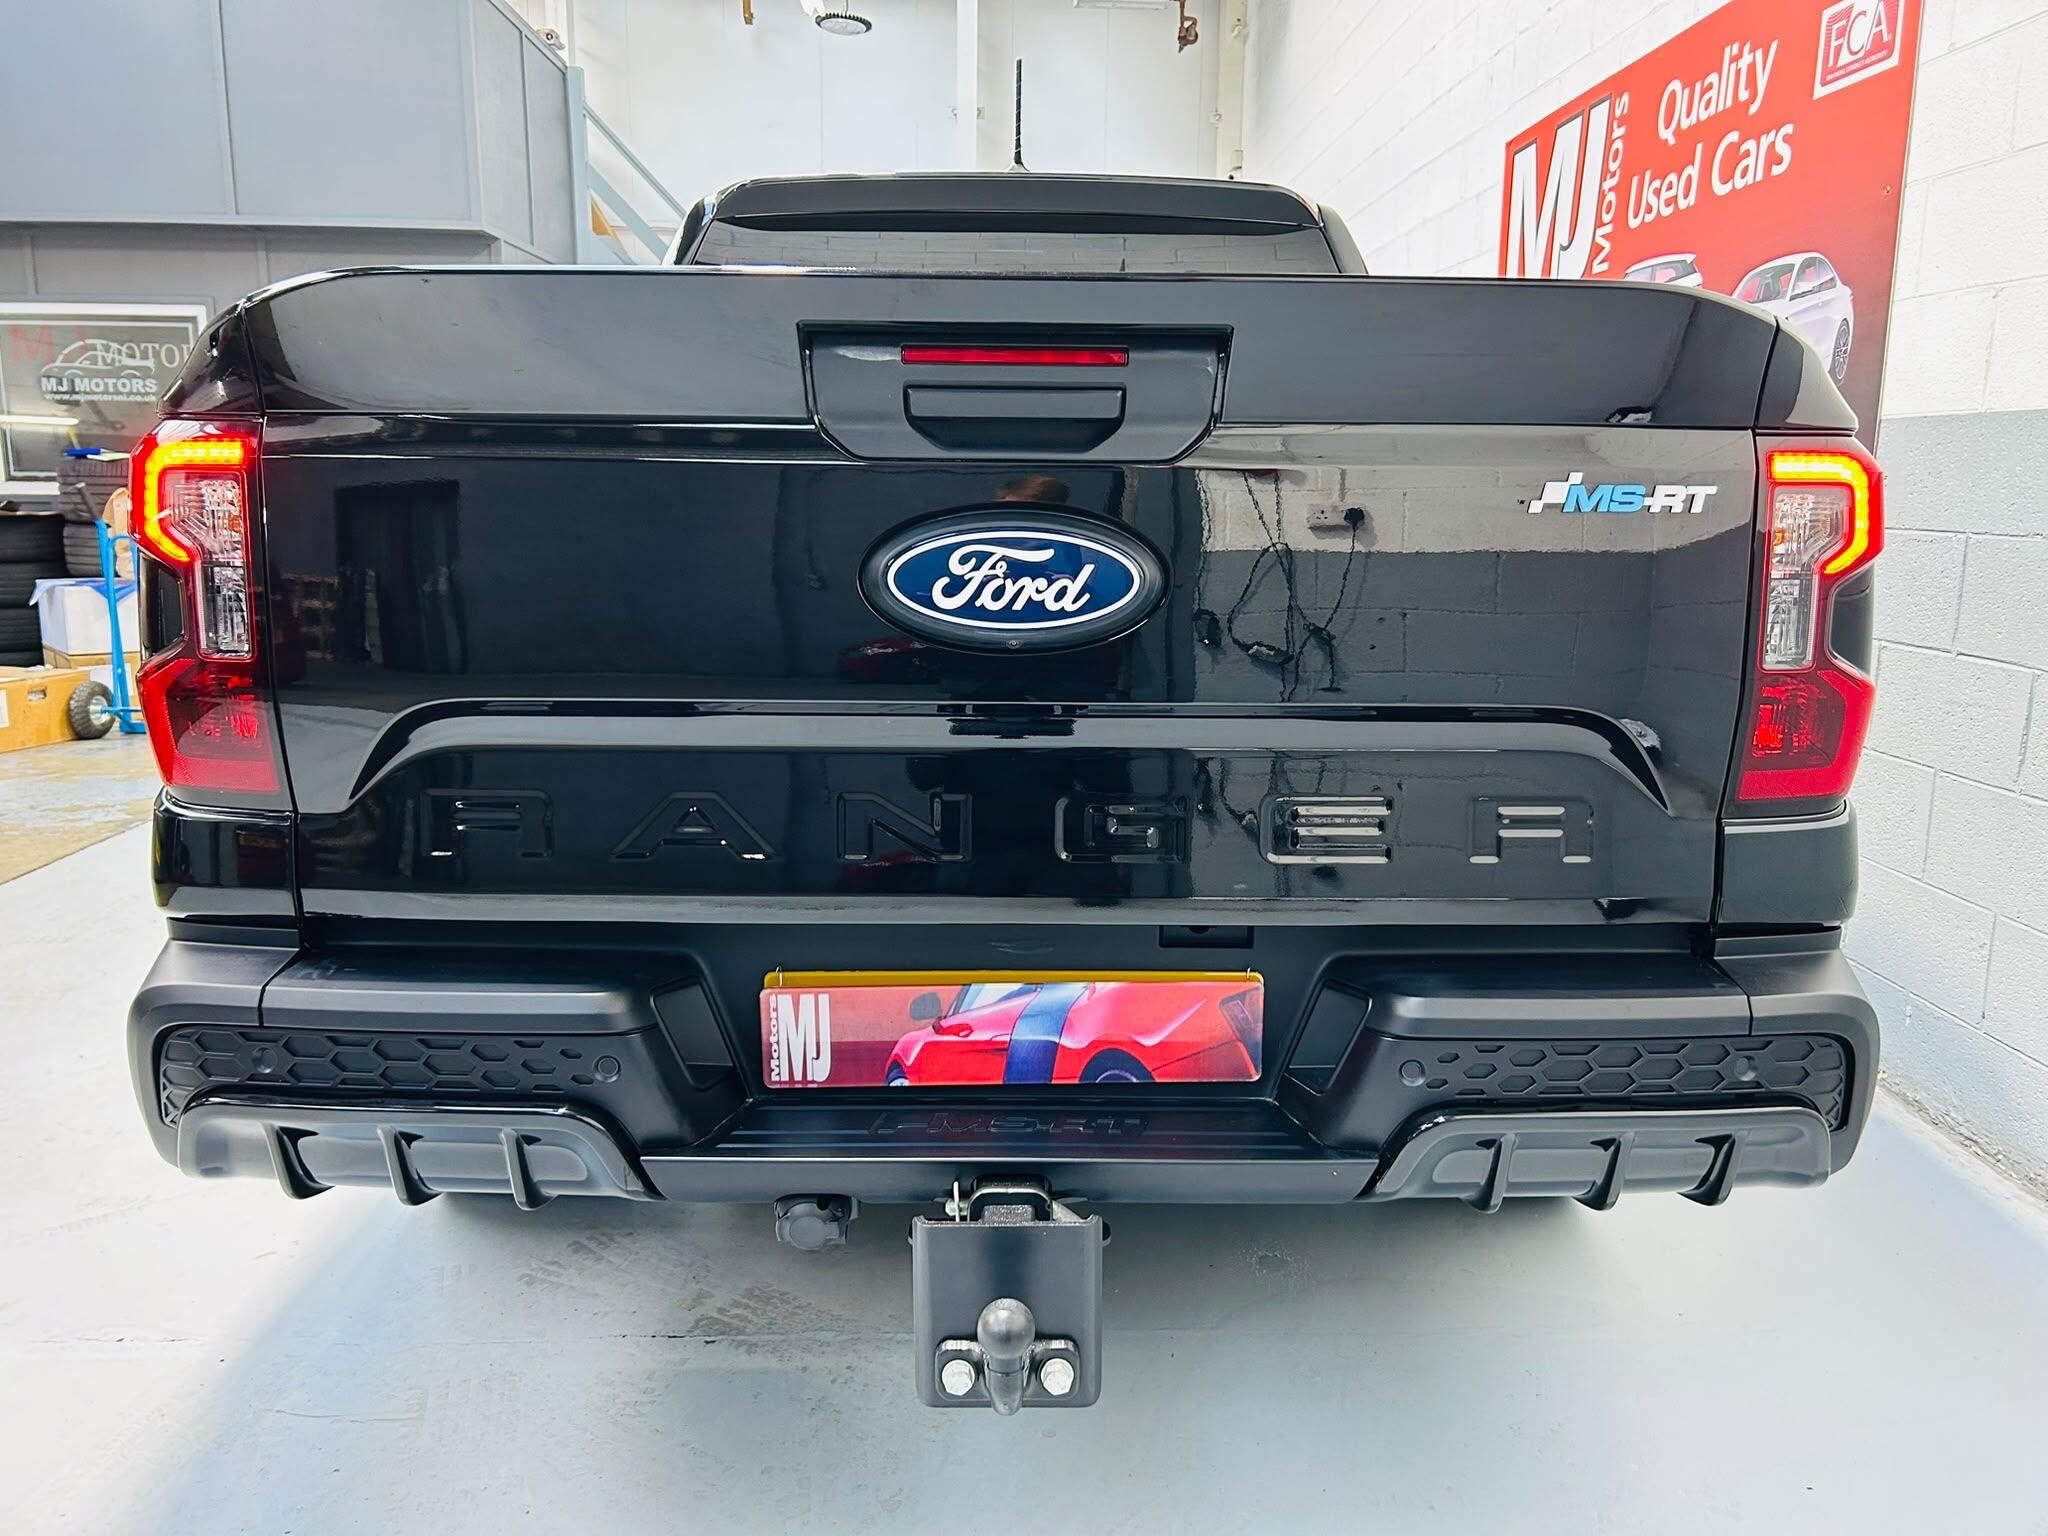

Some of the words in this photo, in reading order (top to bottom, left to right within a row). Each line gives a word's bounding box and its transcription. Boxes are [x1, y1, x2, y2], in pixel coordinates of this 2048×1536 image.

[1827, 0, 1892, 68] FCA
[1658, 39, 1779, 146] Quality
[1505, 92, 1612, 278] MJ
[1591, 91, 1630, 275] Motors
[1626, 142, 1703, 229] Used
[1711, 123, 1794, 197] Cars
[40, 376, 68, 392] MJ
[74, 377, 158, 393] MOTORS
[1562, 484, 1718, 514] MS-RT
[931, 544, 1096, 612] Ford
[420, 788, 1596, 865] RANGER
[769, 992, 781, 1082] Motors
[777, 992, 832, 1083] MJ
